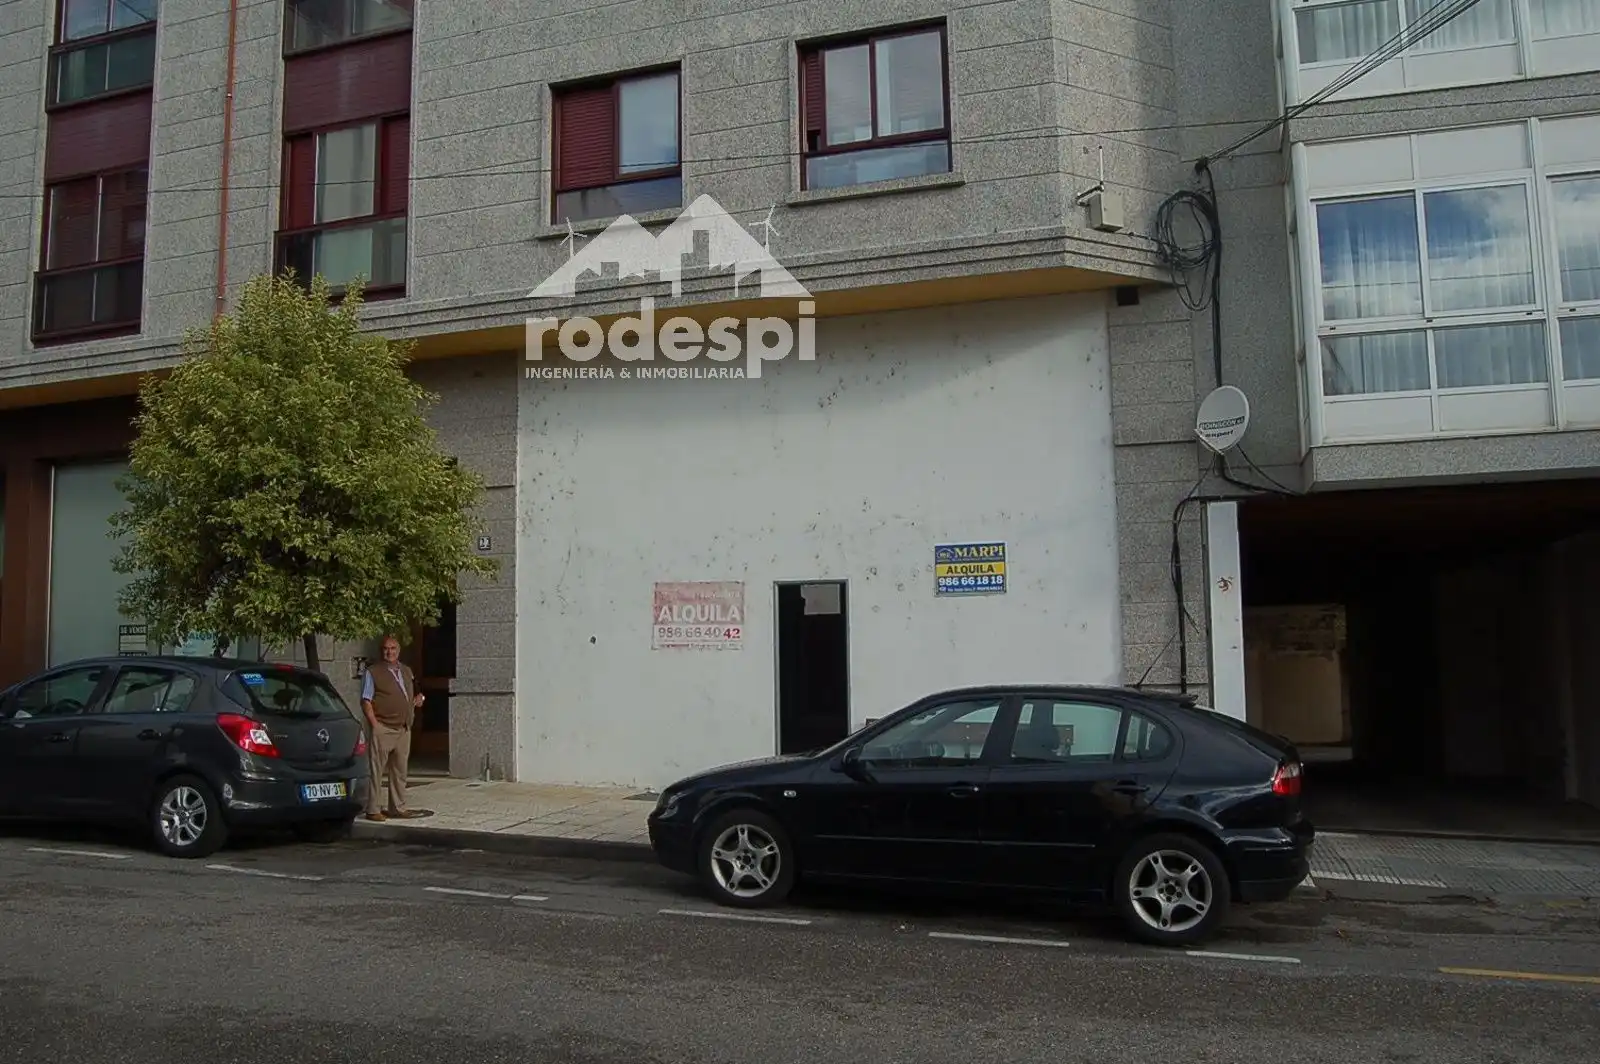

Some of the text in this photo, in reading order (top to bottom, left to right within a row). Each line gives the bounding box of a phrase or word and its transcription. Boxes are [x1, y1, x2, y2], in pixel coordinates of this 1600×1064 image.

[954, 545, 1004, 558] MARPI
[946, 564, 995, 575] ALQUILA
[938, 575, 1003, 586] 986 66 18 18
[658, 603, 741, 623] ALQUILA
[658, 626, 741, 639] 986 66 40 42
